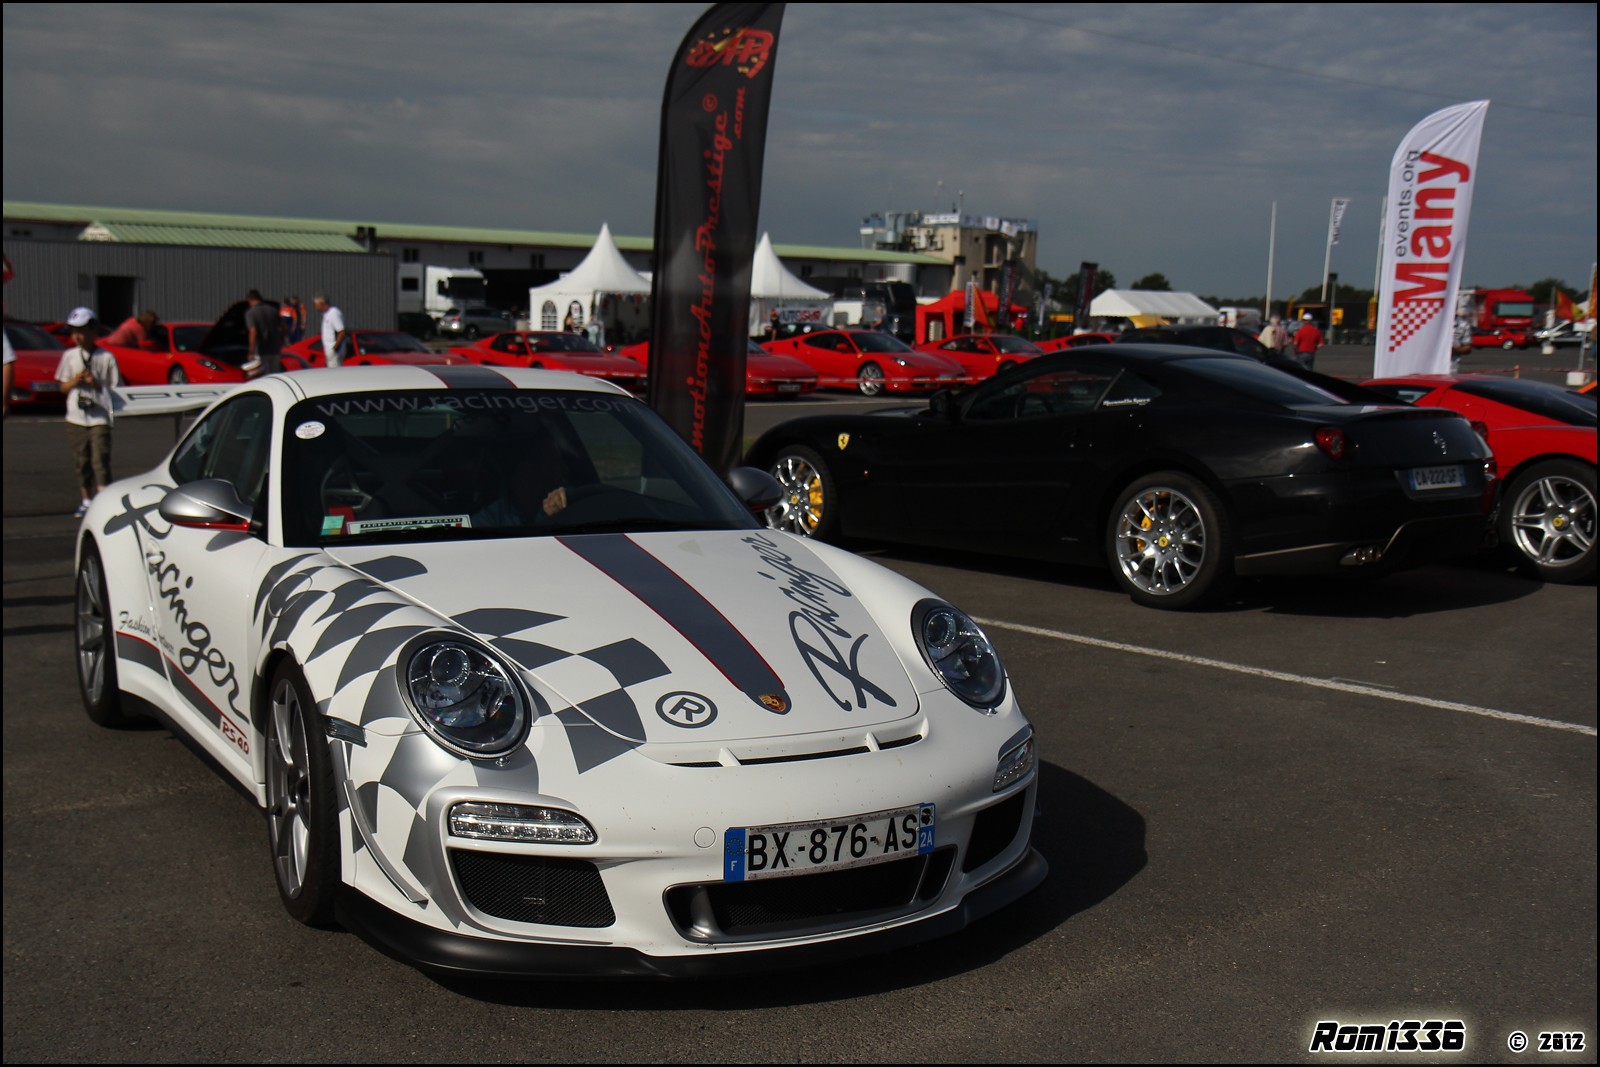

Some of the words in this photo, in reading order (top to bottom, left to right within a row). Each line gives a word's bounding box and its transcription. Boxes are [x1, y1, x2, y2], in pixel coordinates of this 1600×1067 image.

[735, 87, 746, 139] .com
[1393, 151, 1470, 307] Many
[1396, 150, 1421, 257] events.org
[687, 112, 733, 450] motionAutoPrestige
[317, 392, 641, 417] www.racinger.com
[740, 532, 897, 712] Racinger
[920, 832, 934, 848] 2A
